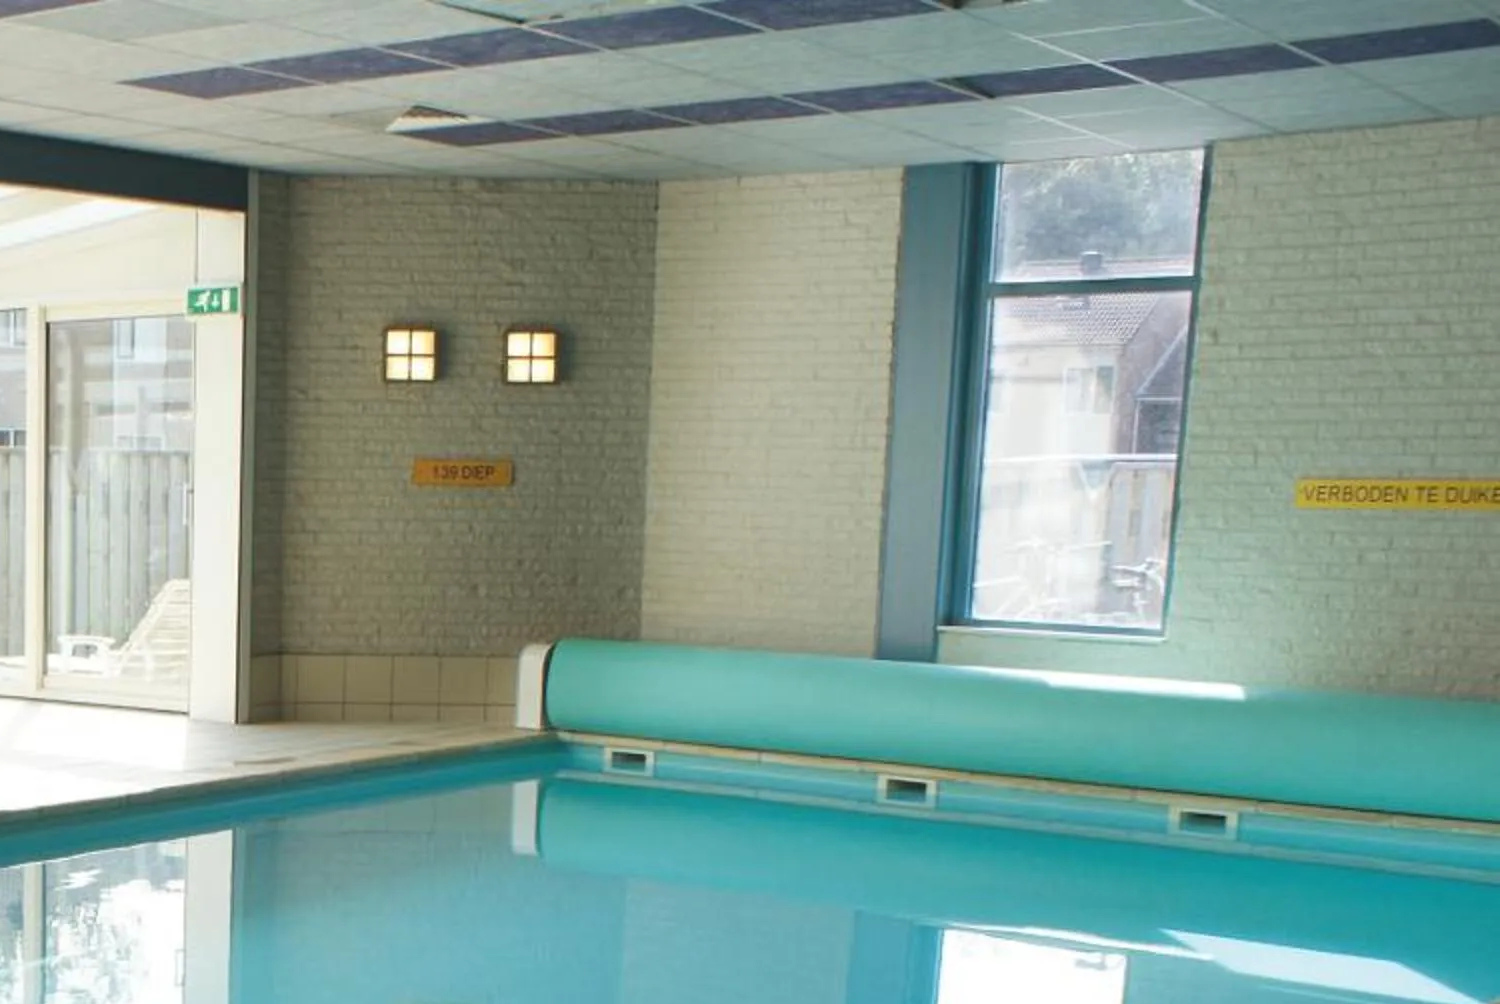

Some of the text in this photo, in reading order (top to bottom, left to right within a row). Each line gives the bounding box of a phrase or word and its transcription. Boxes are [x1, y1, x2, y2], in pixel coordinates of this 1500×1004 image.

[1303, 485, 1500, 504] VERBODEN TE DUIKE
